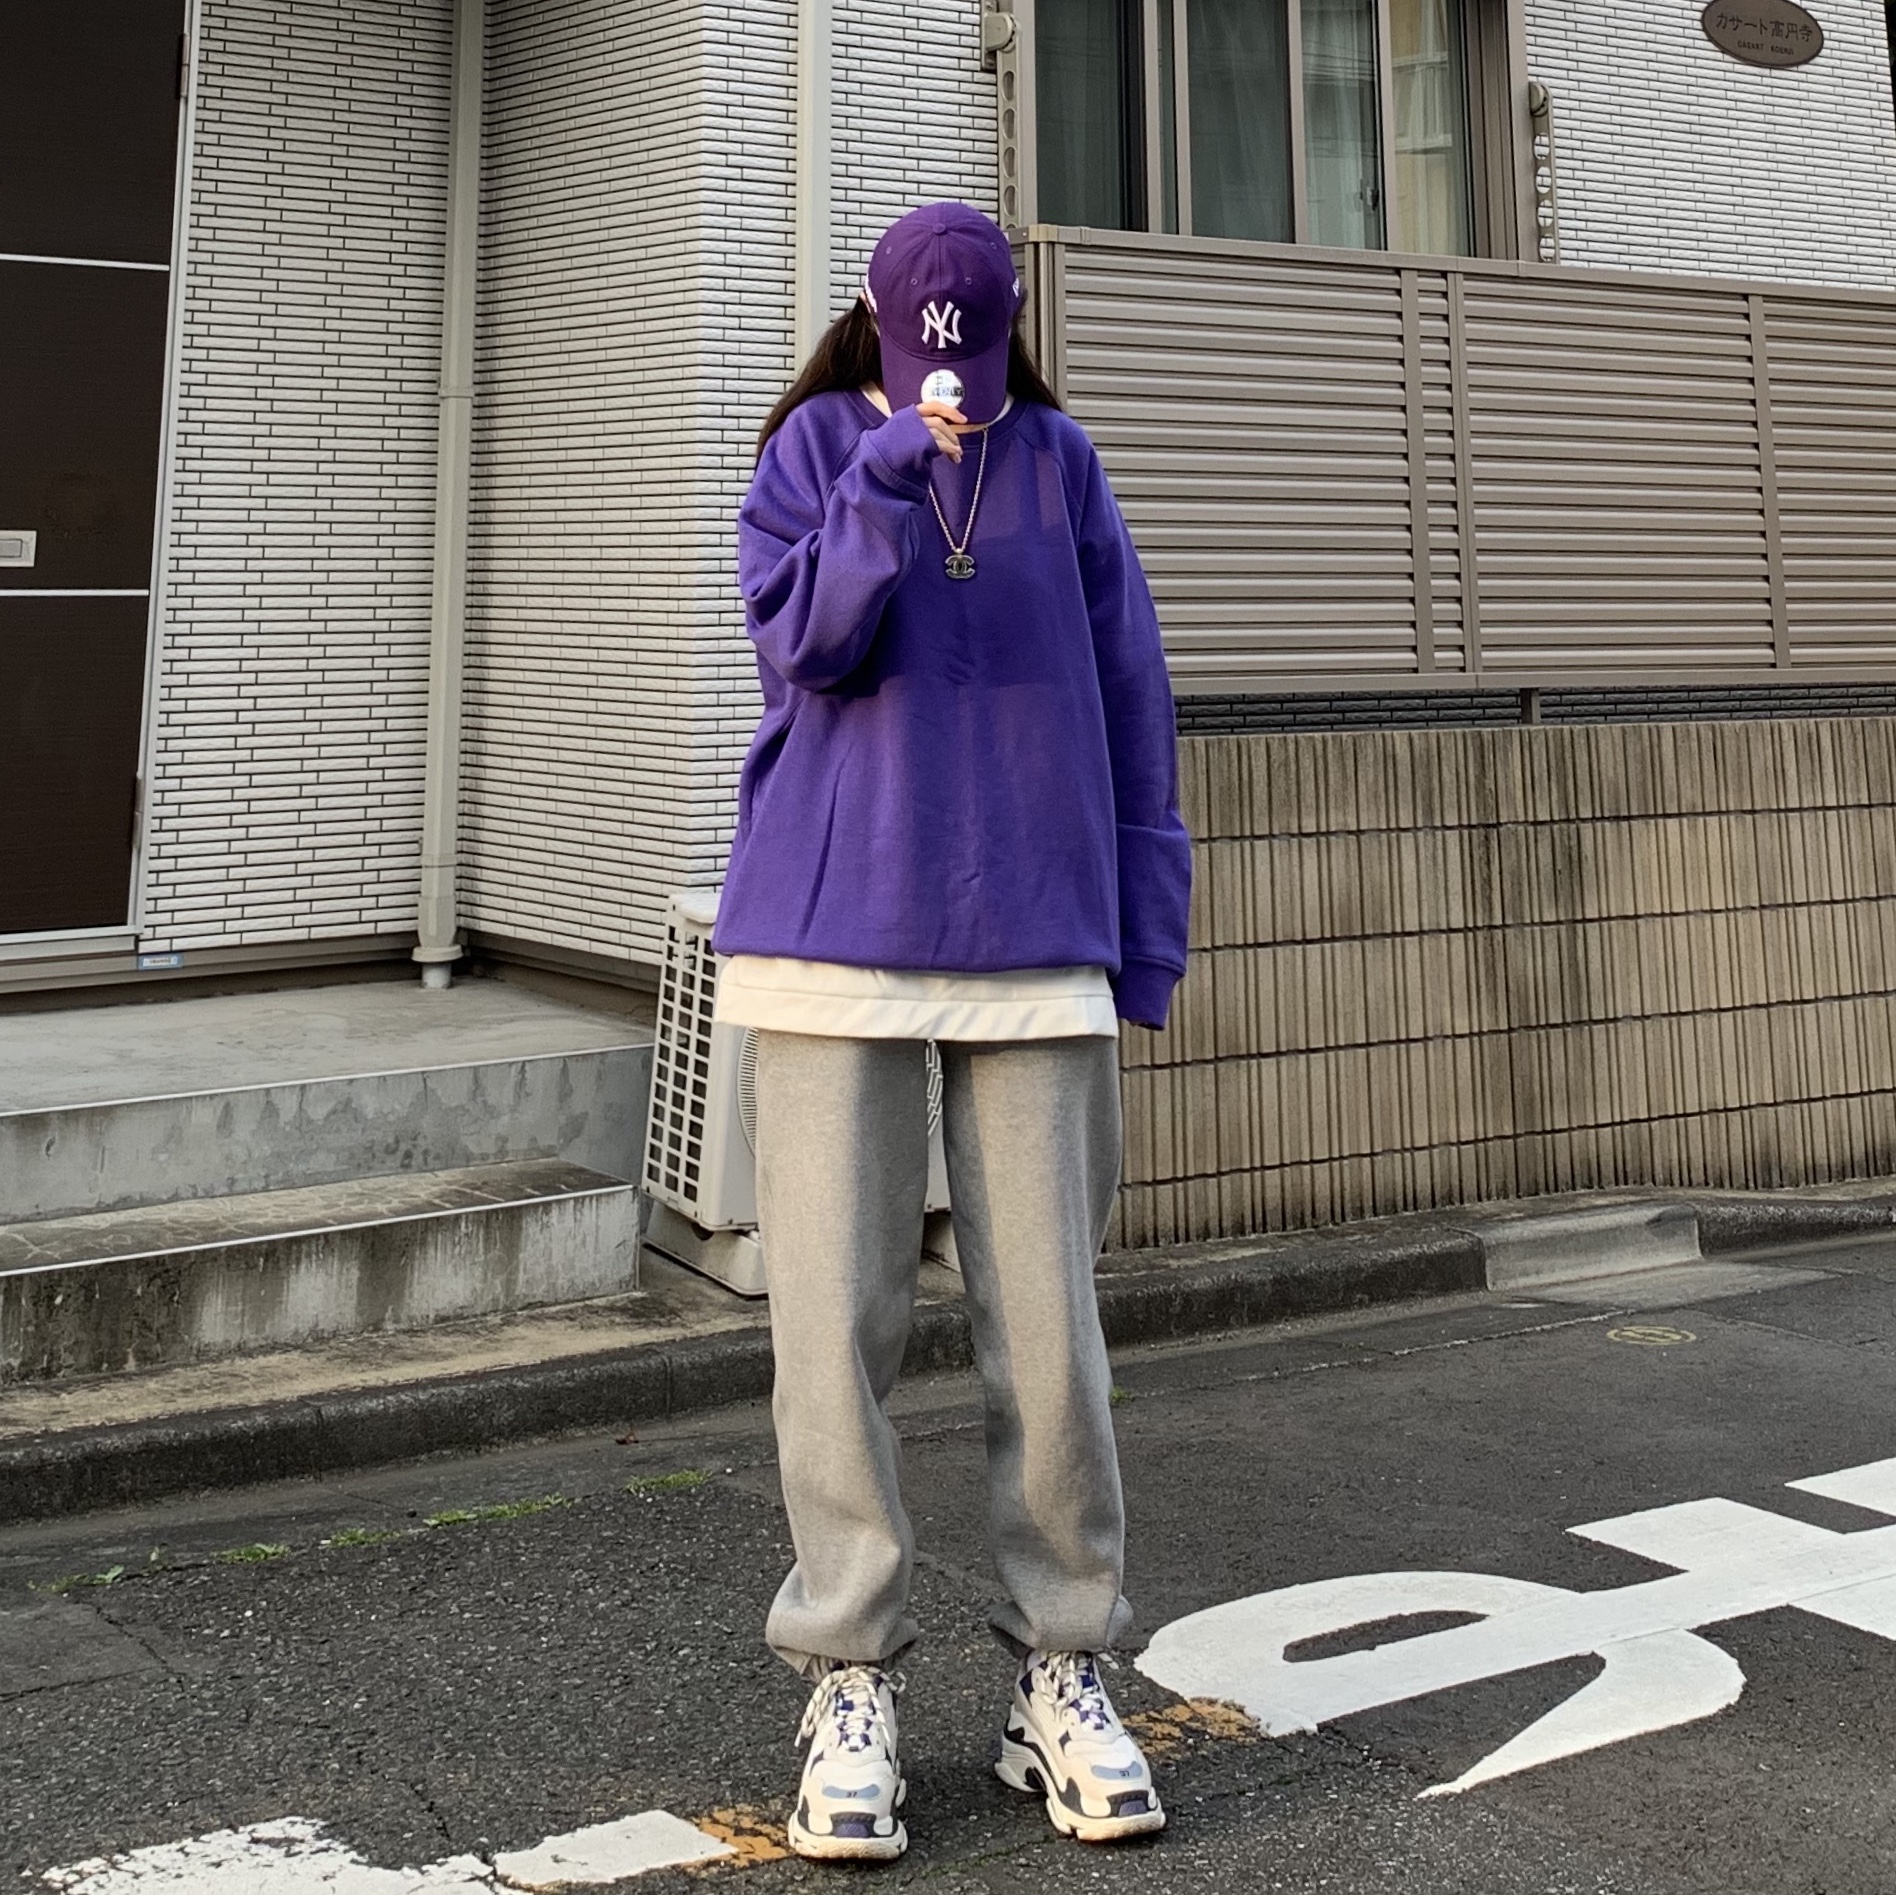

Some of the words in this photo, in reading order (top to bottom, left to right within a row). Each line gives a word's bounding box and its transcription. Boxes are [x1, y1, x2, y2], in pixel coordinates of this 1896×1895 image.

[1715, 12, 1813, 43] カサート高円寺
[921, 300, 962, 349] NY
